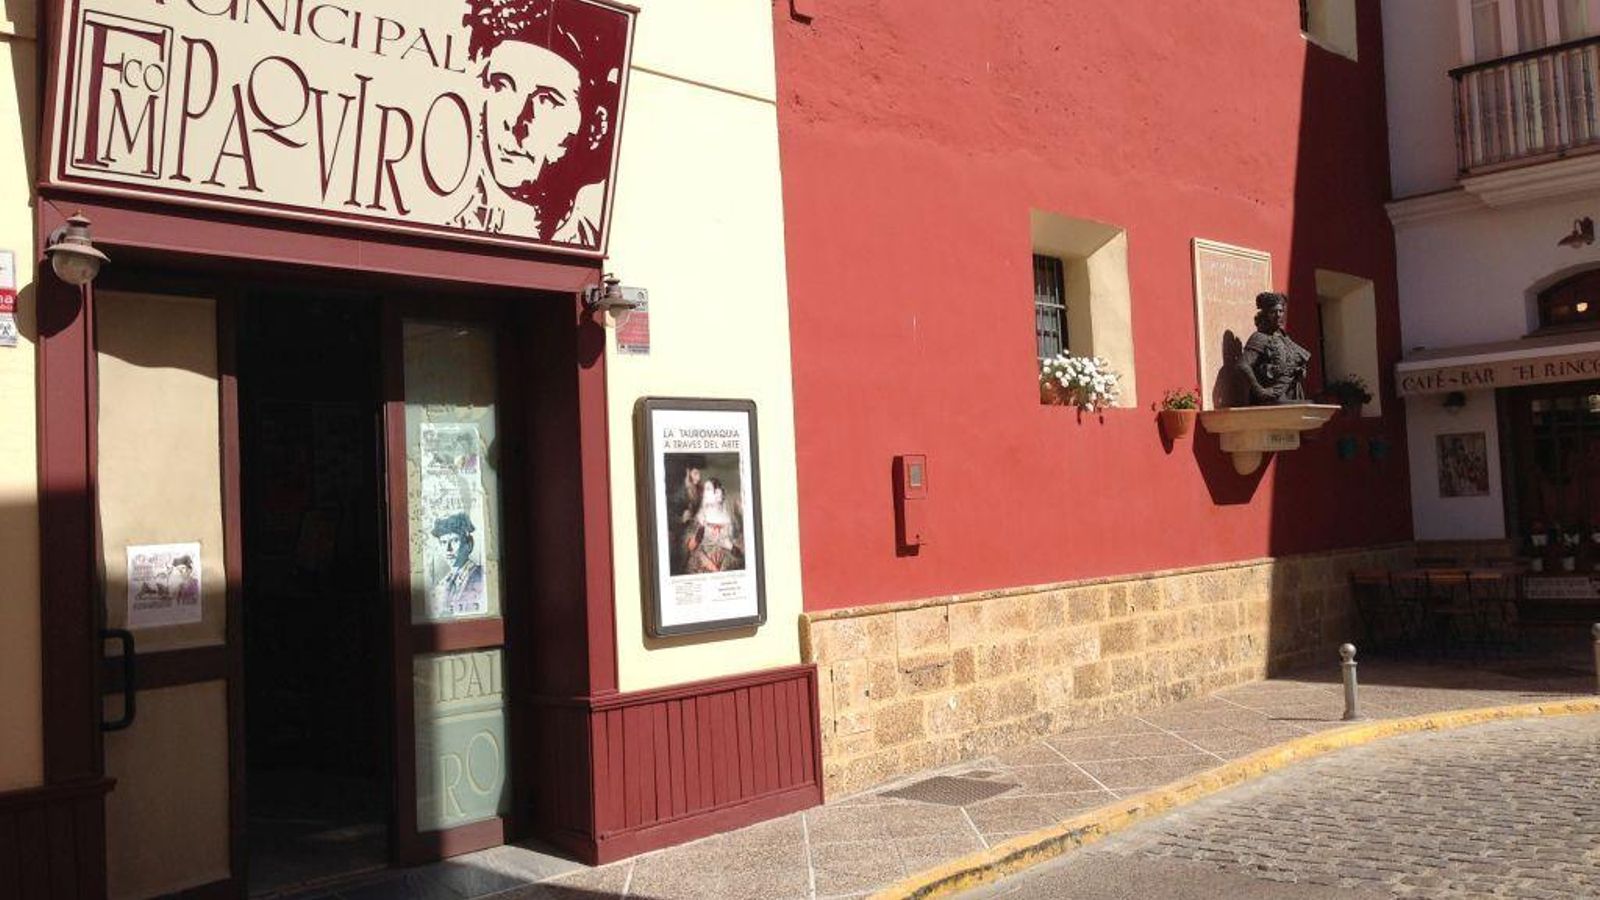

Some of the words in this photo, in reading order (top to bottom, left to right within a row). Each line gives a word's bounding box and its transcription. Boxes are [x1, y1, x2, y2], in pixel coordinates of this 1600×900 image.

[663, 429, 674, 438] LA
[679, 429, 740, 438] TAUROMAQUIA
[664, 440, 671, 449] A
[704, 440, 720, 449] DEL
[721, 440, 740, 449] ARTE
